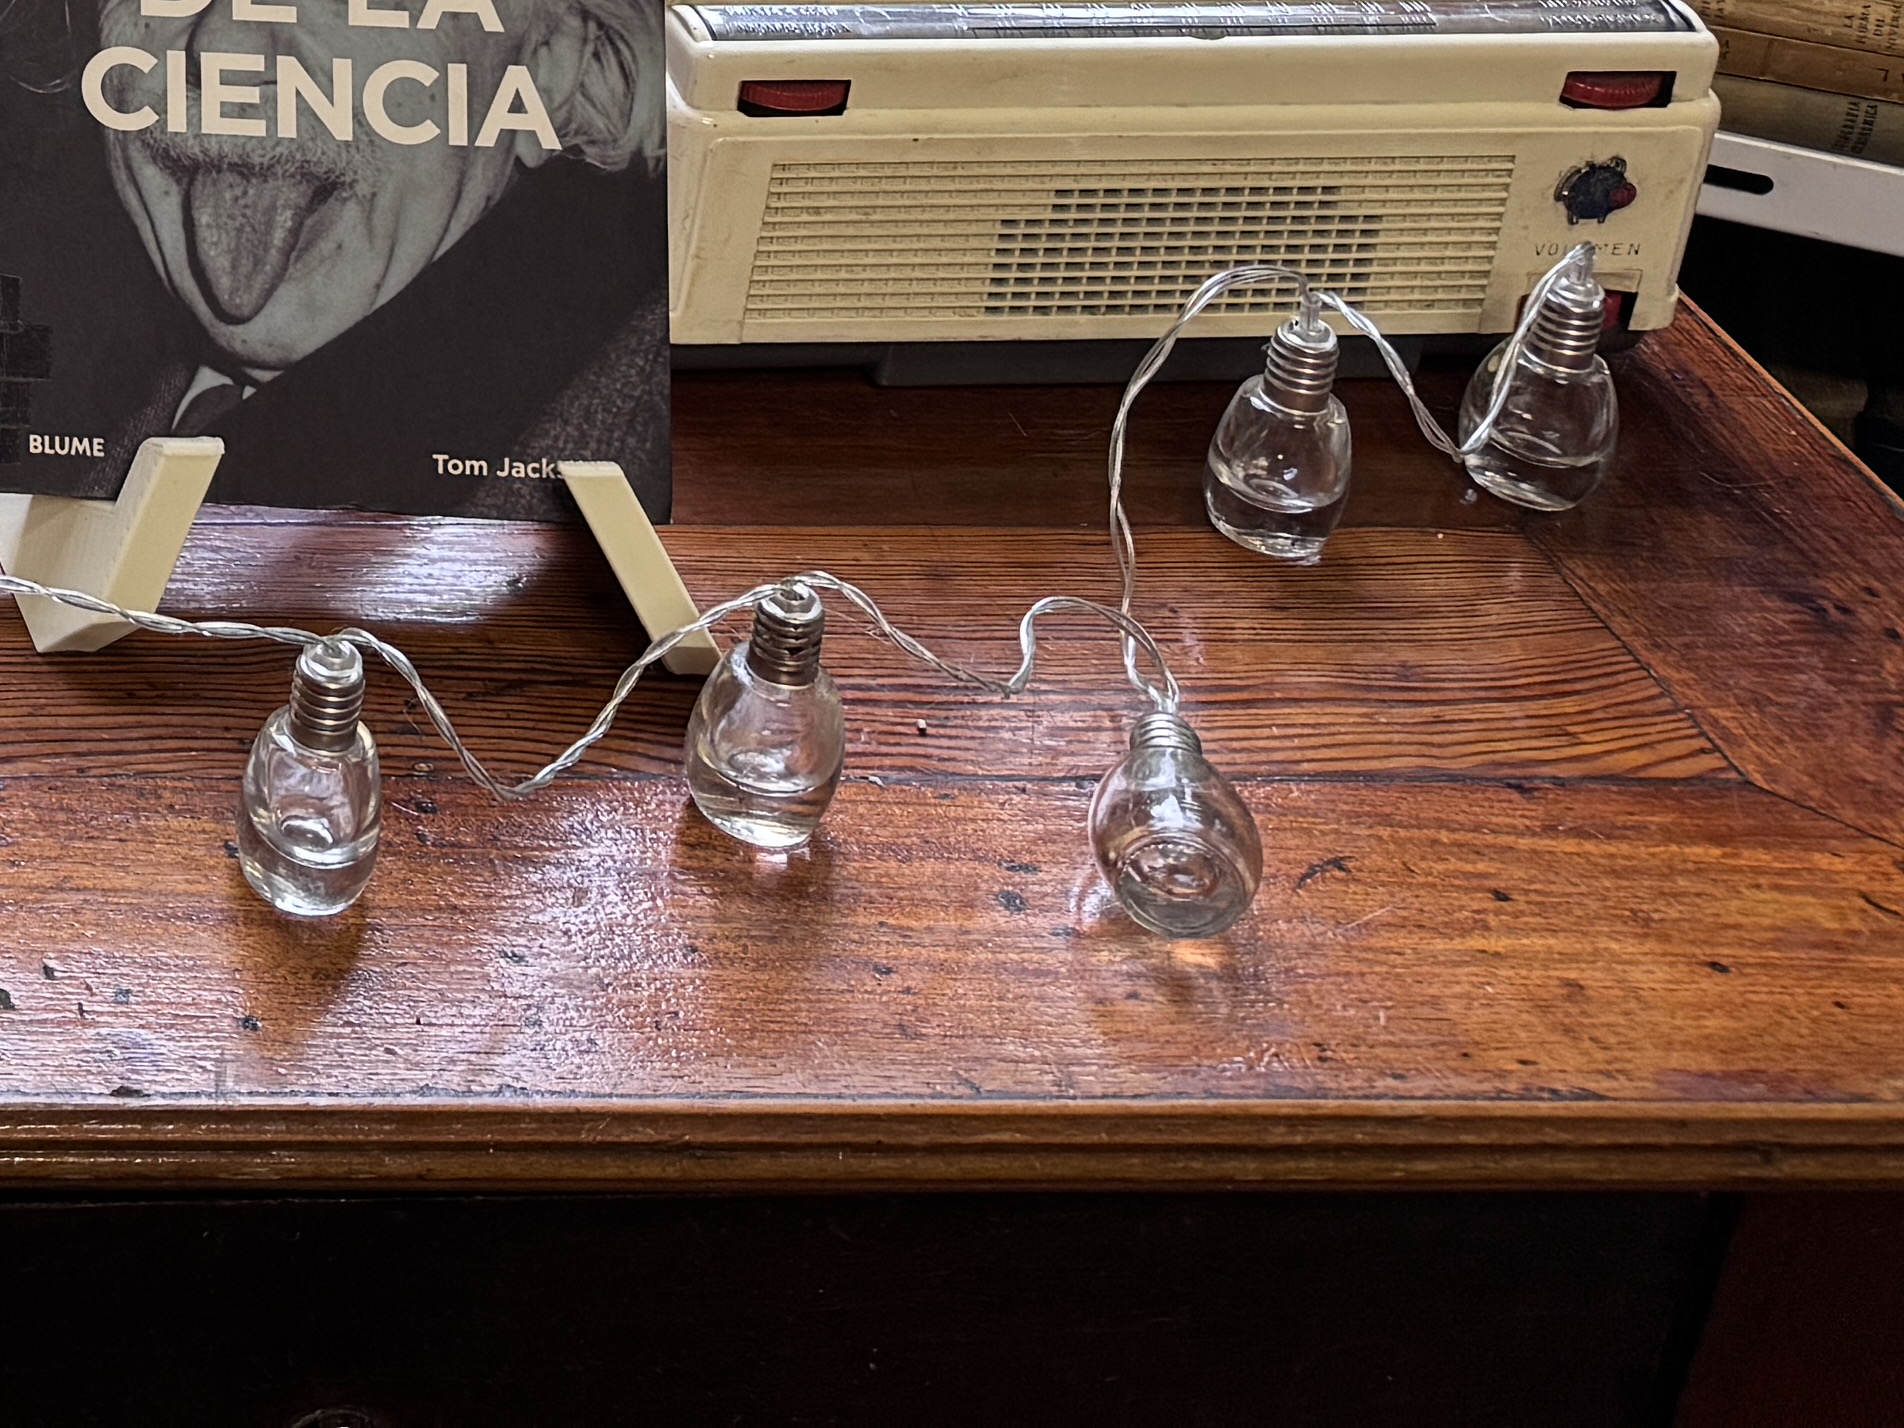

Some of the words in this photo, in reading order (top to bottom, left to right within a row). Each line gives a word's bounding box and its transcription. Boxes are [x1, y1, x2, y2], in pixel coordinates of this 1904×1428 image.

[81, 46, 563, 151] CIENCIA
[29, 434, 106, 457] BLUME
[432, 453, 488, 476] Tom
[496, 456, 565, 480] Jack
